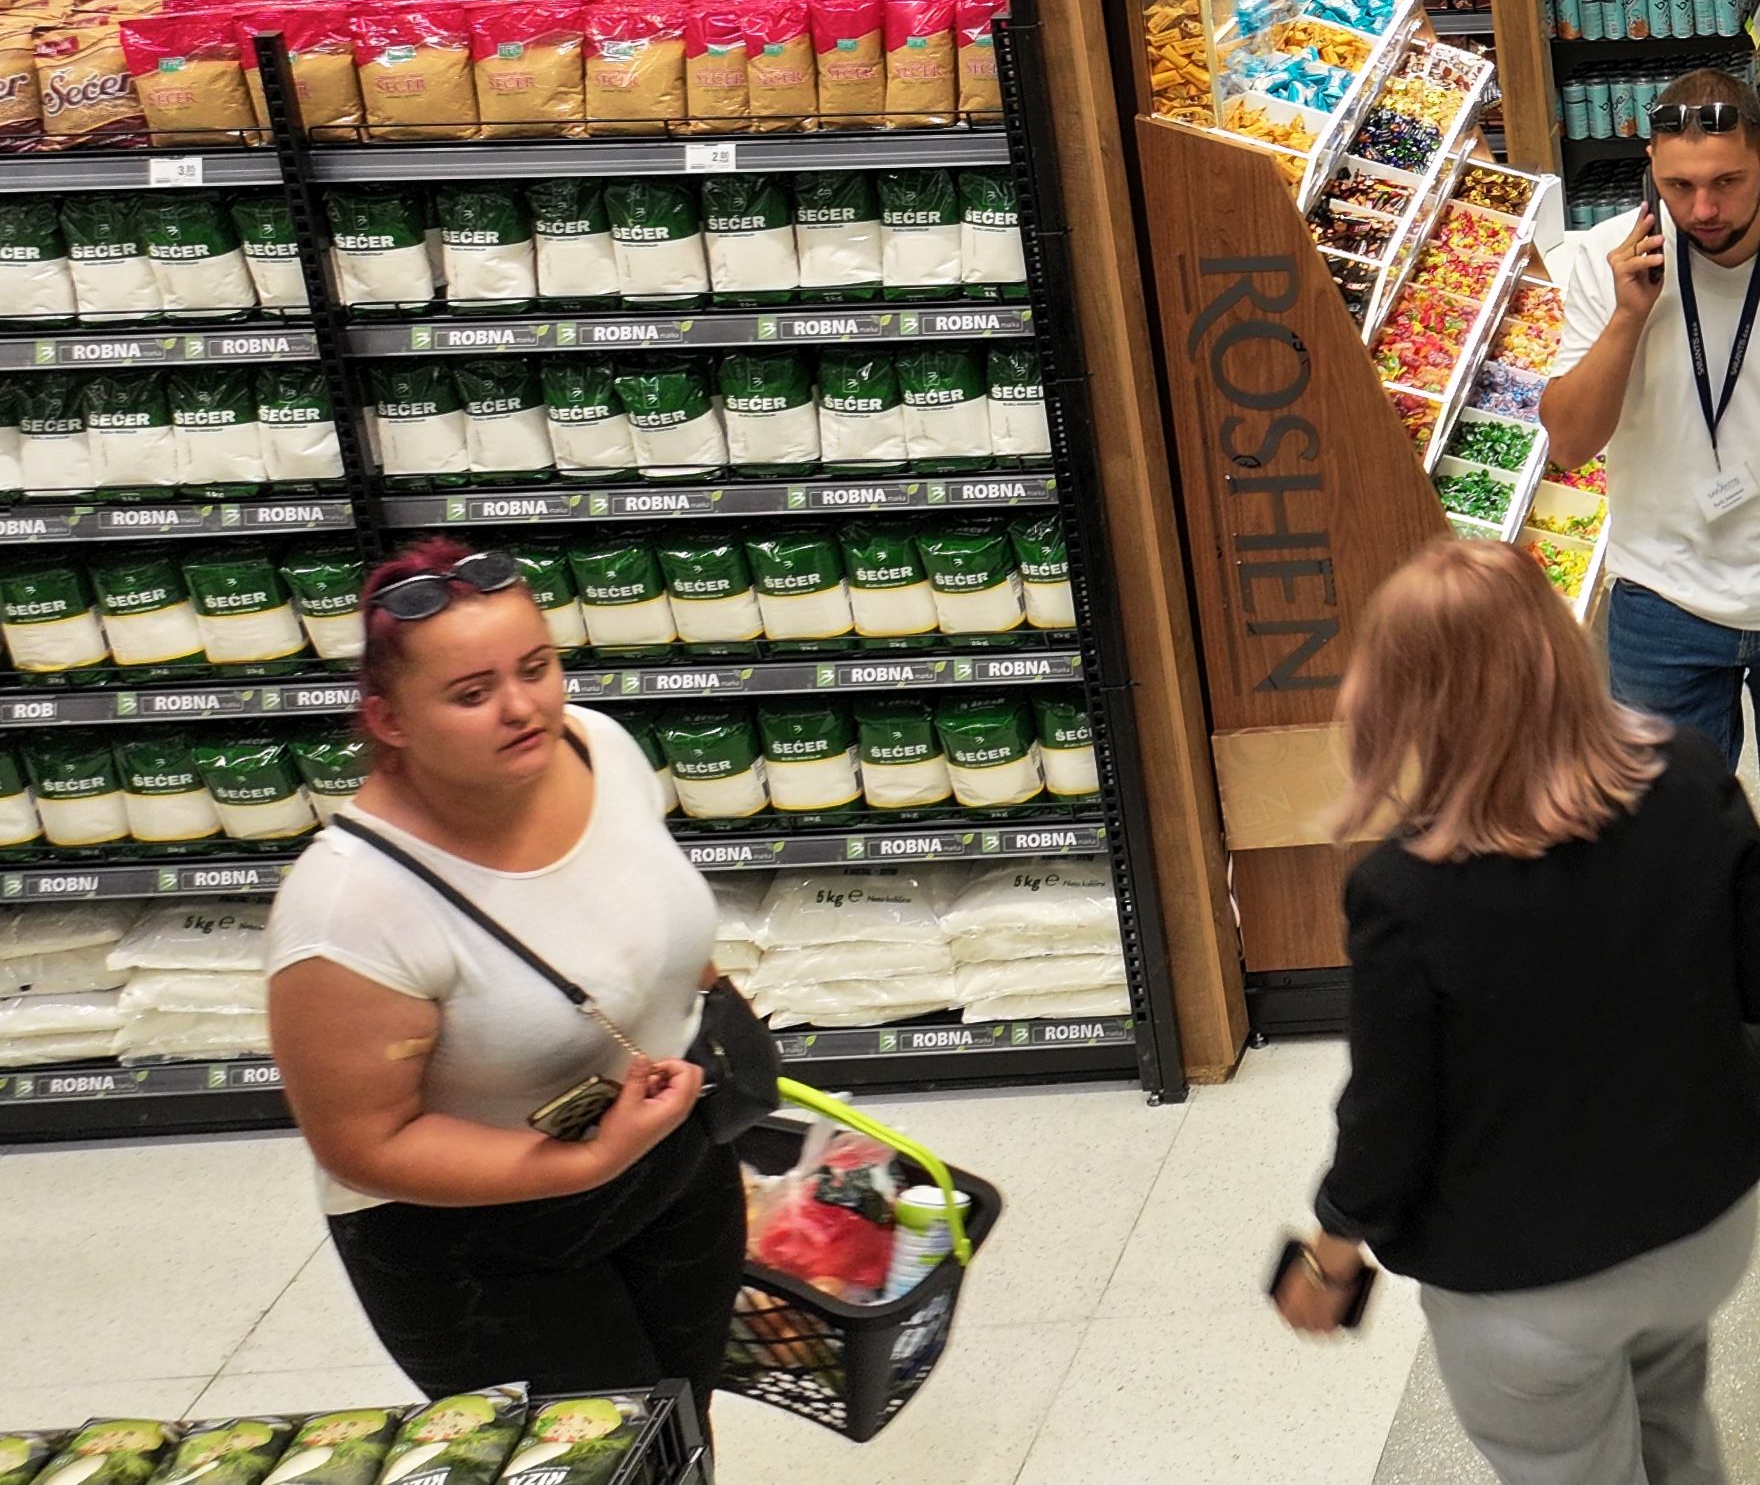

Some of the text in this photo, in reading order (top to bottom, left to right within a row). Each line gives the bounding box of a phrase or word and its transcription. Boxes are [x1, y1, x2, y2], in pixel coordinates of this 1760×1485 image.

[43, 68, 137, 113] Šećer
[883, 209, 940, 225] ŠEĆER
[71, 240, 138, 259] ŠEĆER
[935, 313, 1000, 329] ROBNA
[72, 342, 142, 361] ROBNA
[823, 395, 883, 411] ŠEĆER
[1187, 253, 1343, 692] ROSHEN
[205, 591, 267, 608] ŠEĆER
[1016, 833, 1077, 848] ROBNA
[816, 890, 844, 907] 5 kg
[912, 1031, 973, 1047] ROBNA
